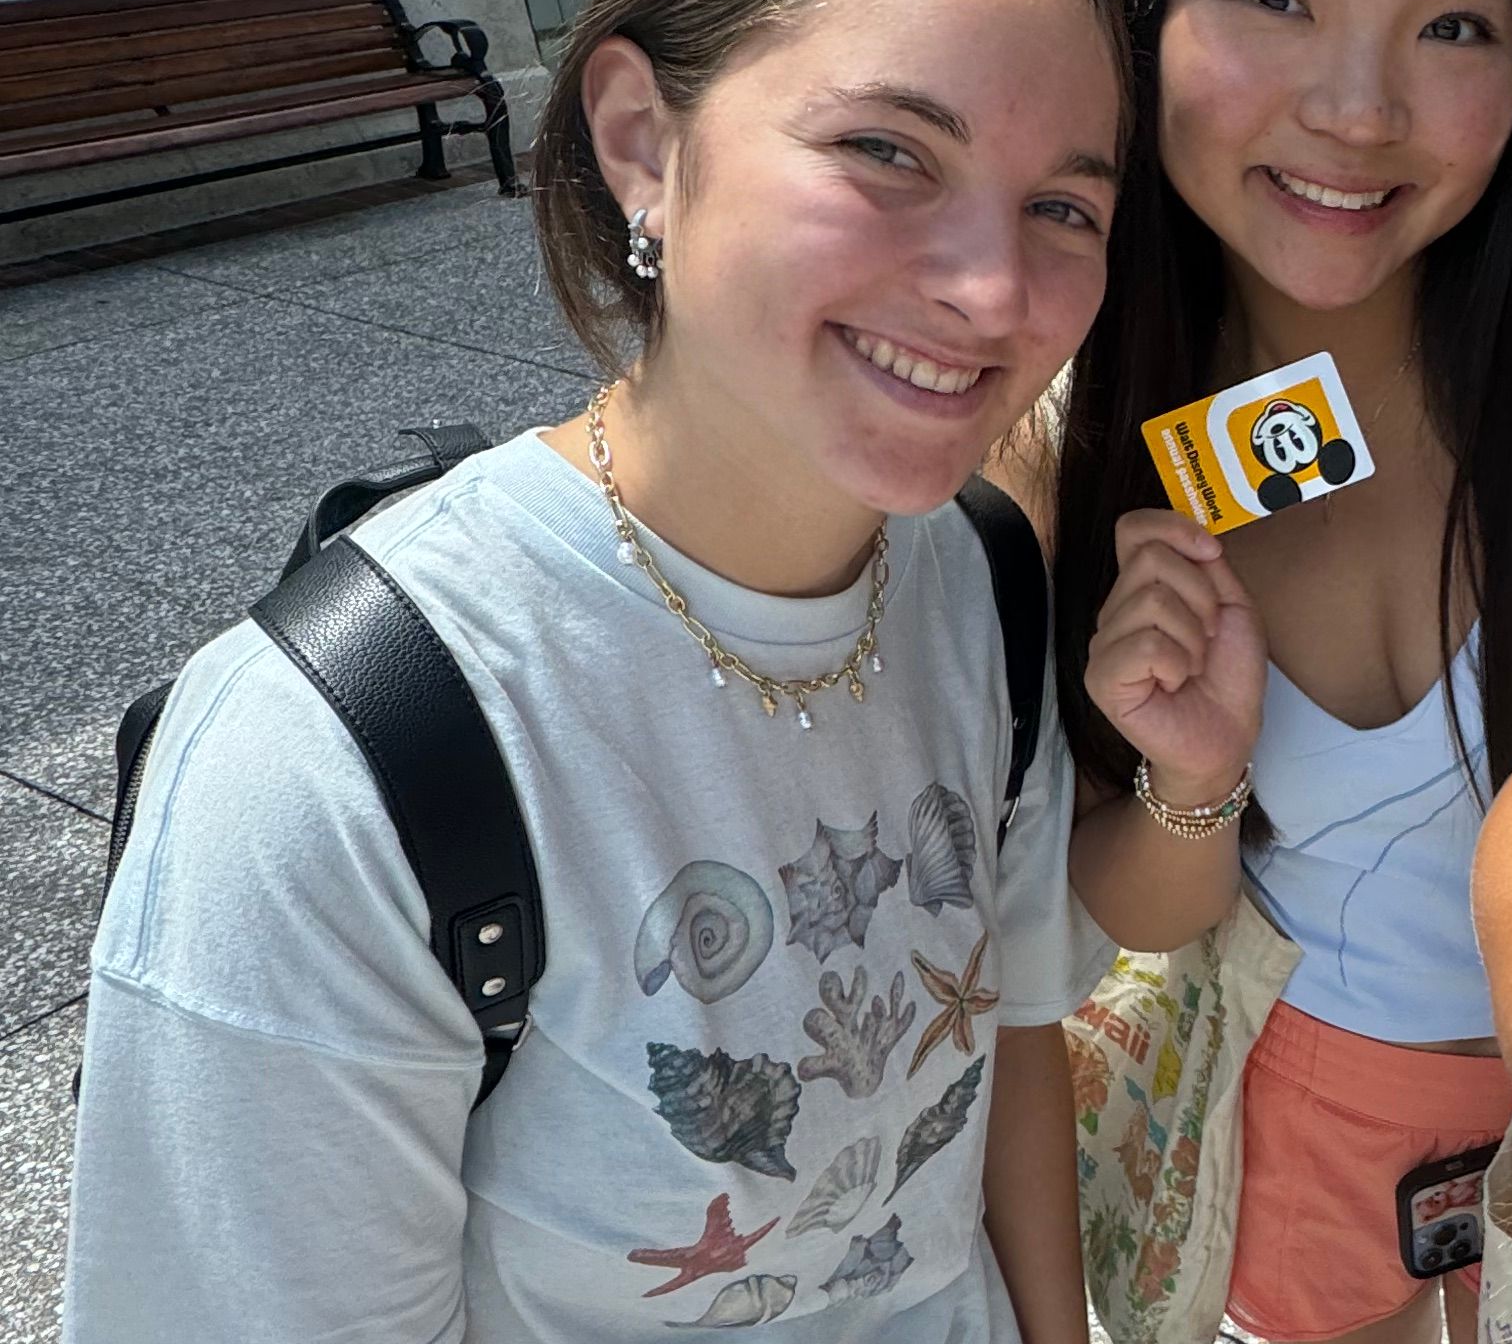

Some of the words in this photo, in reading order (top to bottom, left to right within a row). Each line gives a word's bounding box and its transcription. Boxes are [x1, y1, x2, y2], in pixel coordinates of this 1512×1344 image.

[1161, 428, 1184, 466] annual
[1175, 421, 1195, 452] Walt
[1186, 450, 1208, 490] Disney
[1202, 487, 1223, 522] World
